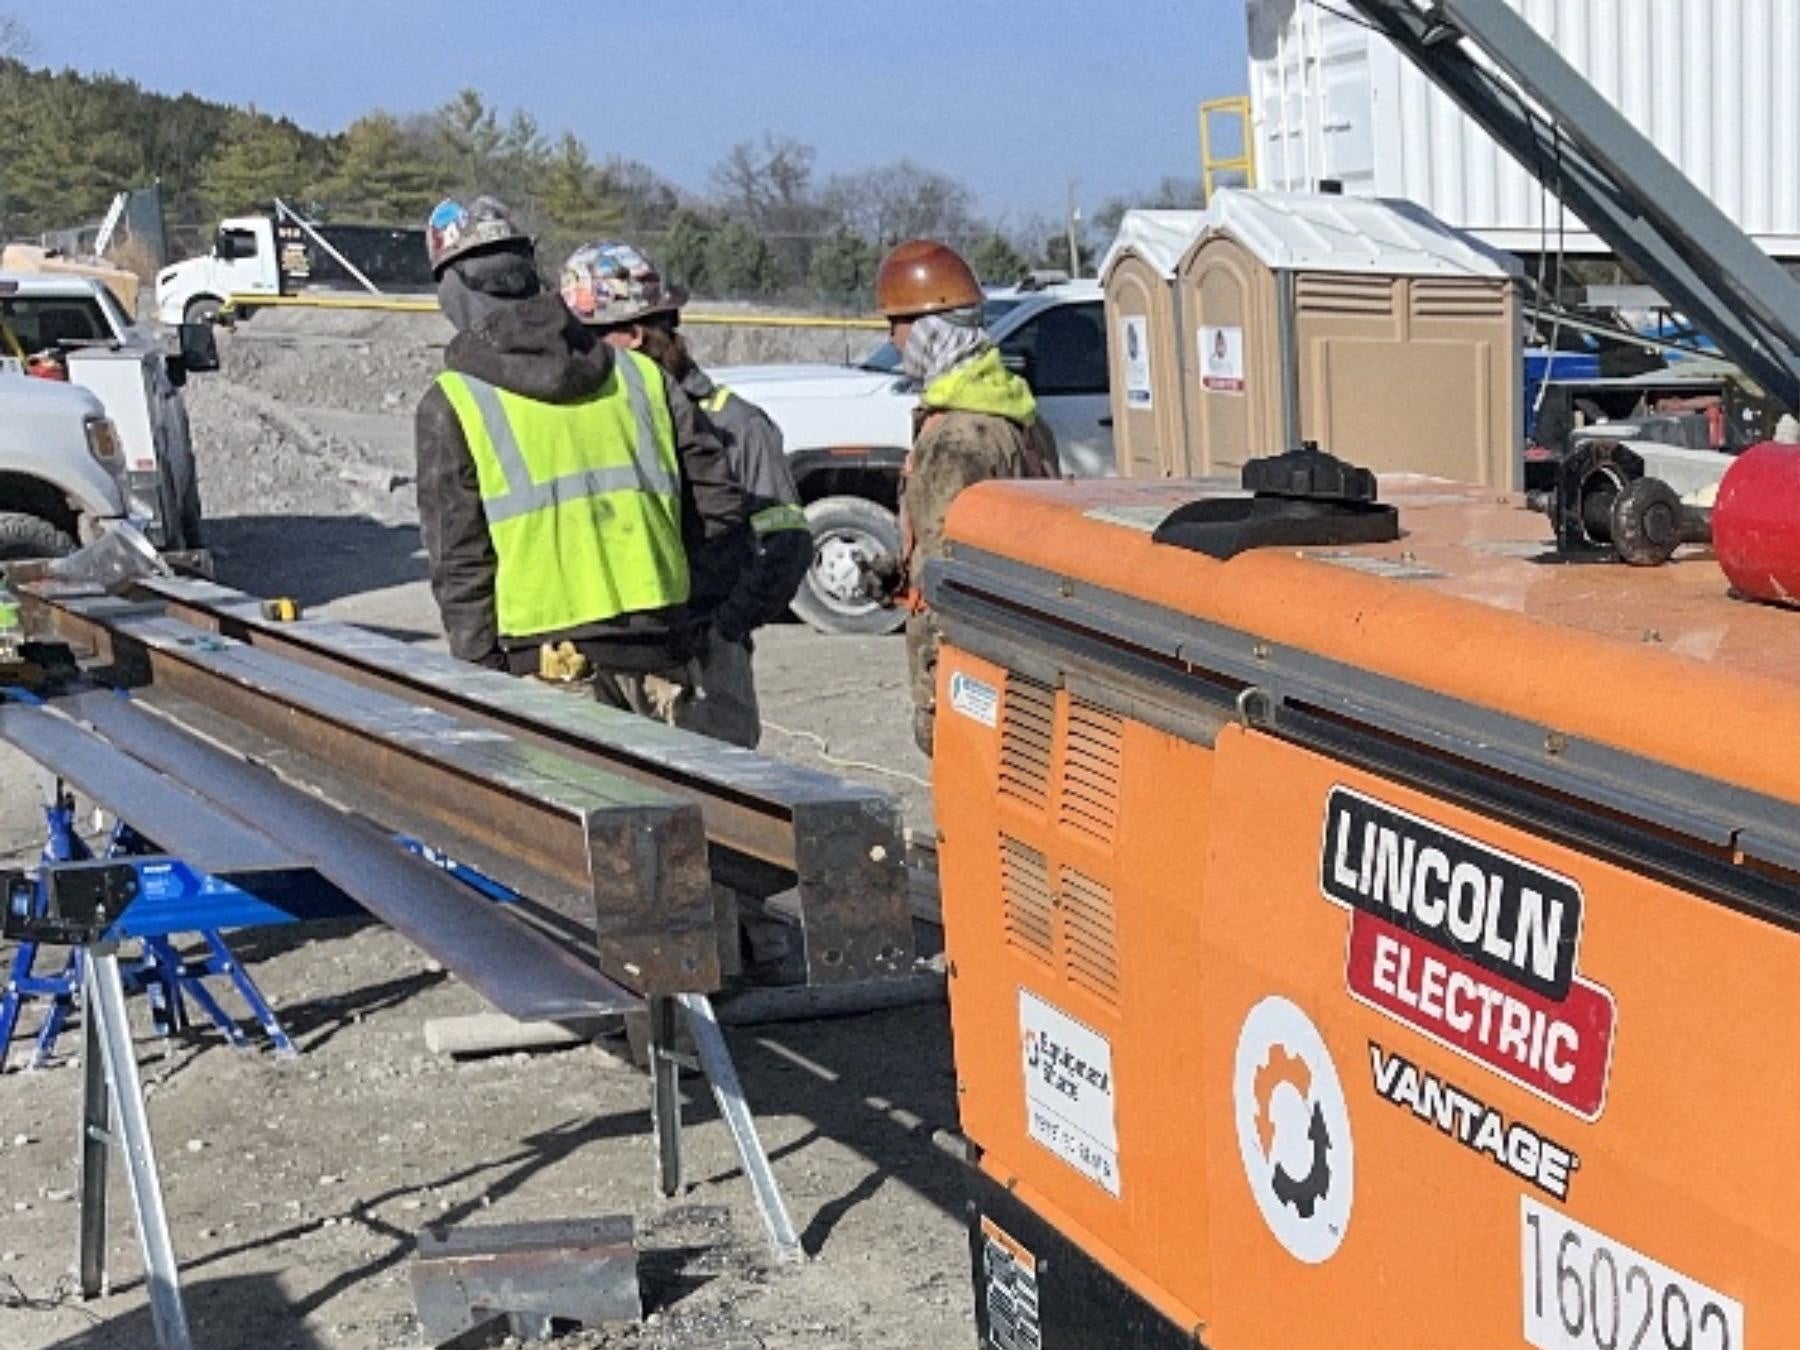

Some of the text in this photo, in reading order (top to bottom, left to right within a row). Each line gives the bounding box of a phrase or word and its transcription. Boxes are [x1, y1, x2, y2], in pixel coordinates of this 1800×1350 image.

[1334, 808, 1564, 983] LINCOLN
[1372, 933, 1580, 1085] ELECTRIC
[1369, 1041, 1574, 1202] VANTAGE
